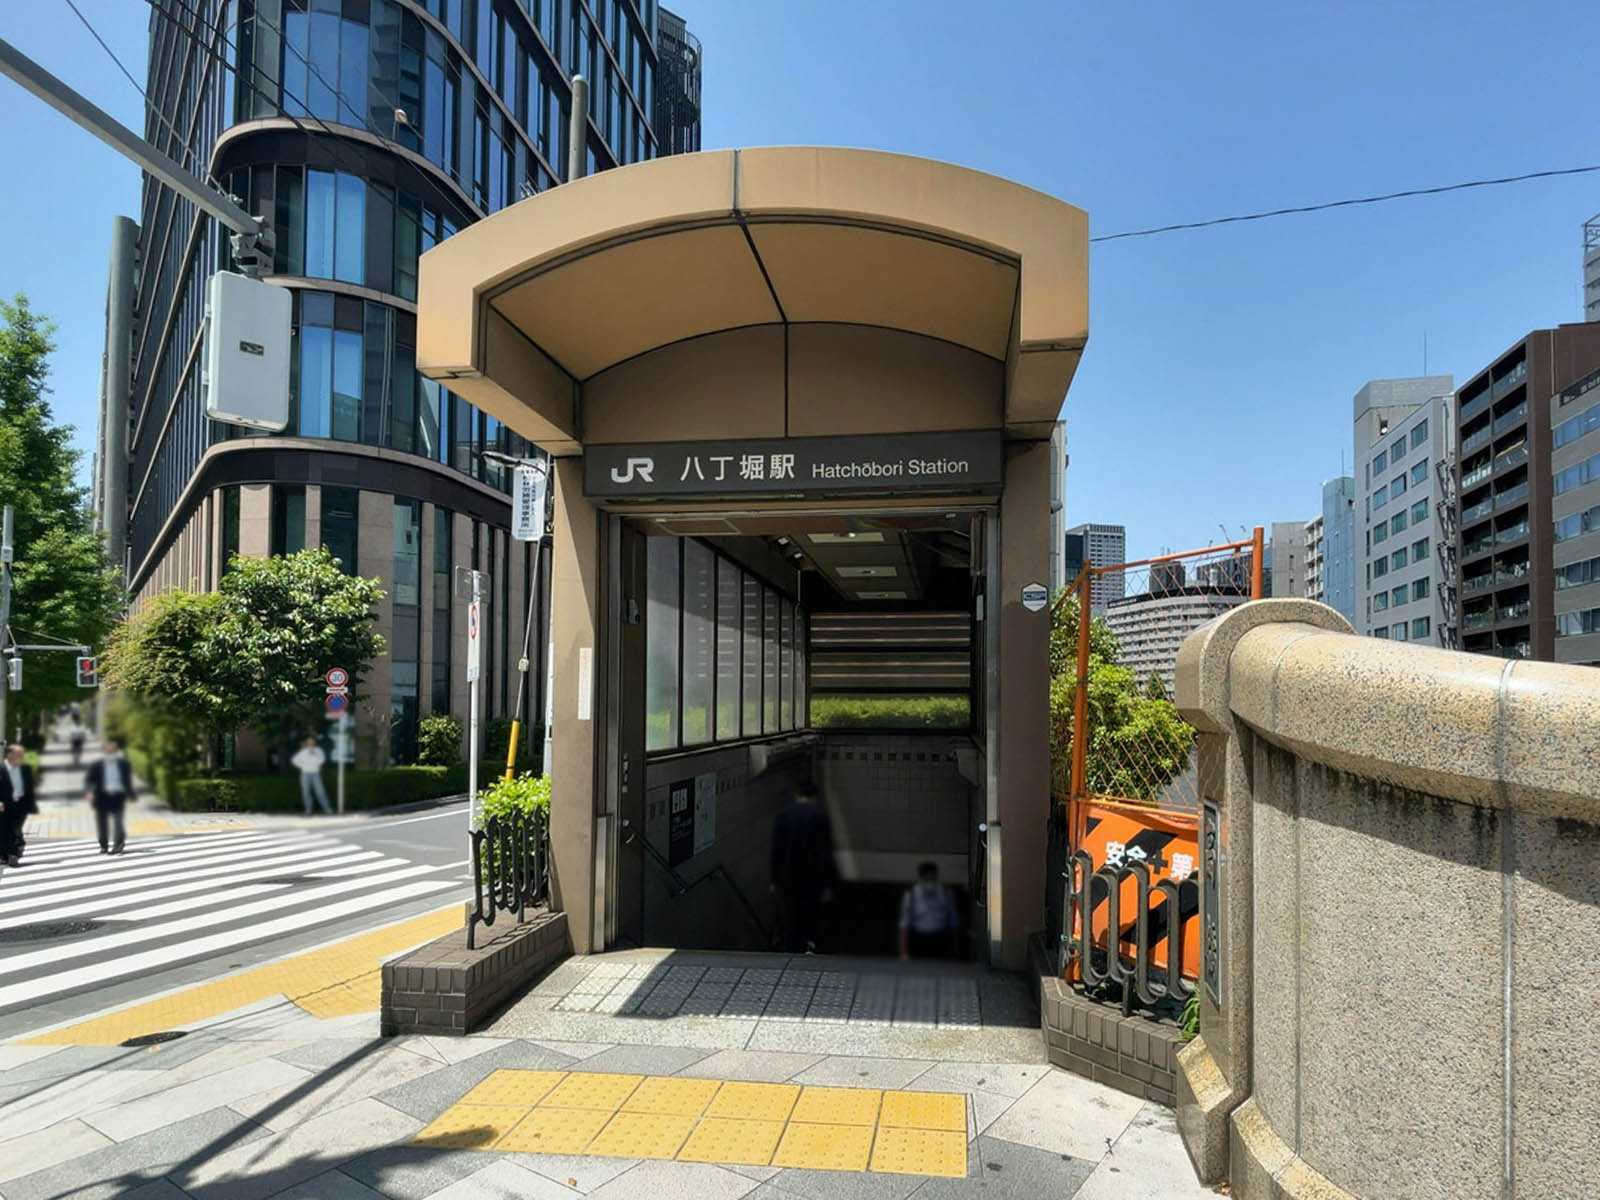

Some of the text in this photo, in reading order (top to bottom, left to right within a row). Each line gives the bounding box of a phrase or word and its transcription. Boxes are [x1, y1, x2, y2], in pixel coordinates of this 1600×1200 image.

[611, 457, 654, 483] JR
[680, 454, 795, 481] 八丁堀駅
[812, 458, 968, 478] Hatchōbori Station
[332, 673, 343, 682] 30
[1170, 852, 1199, 880] 第
